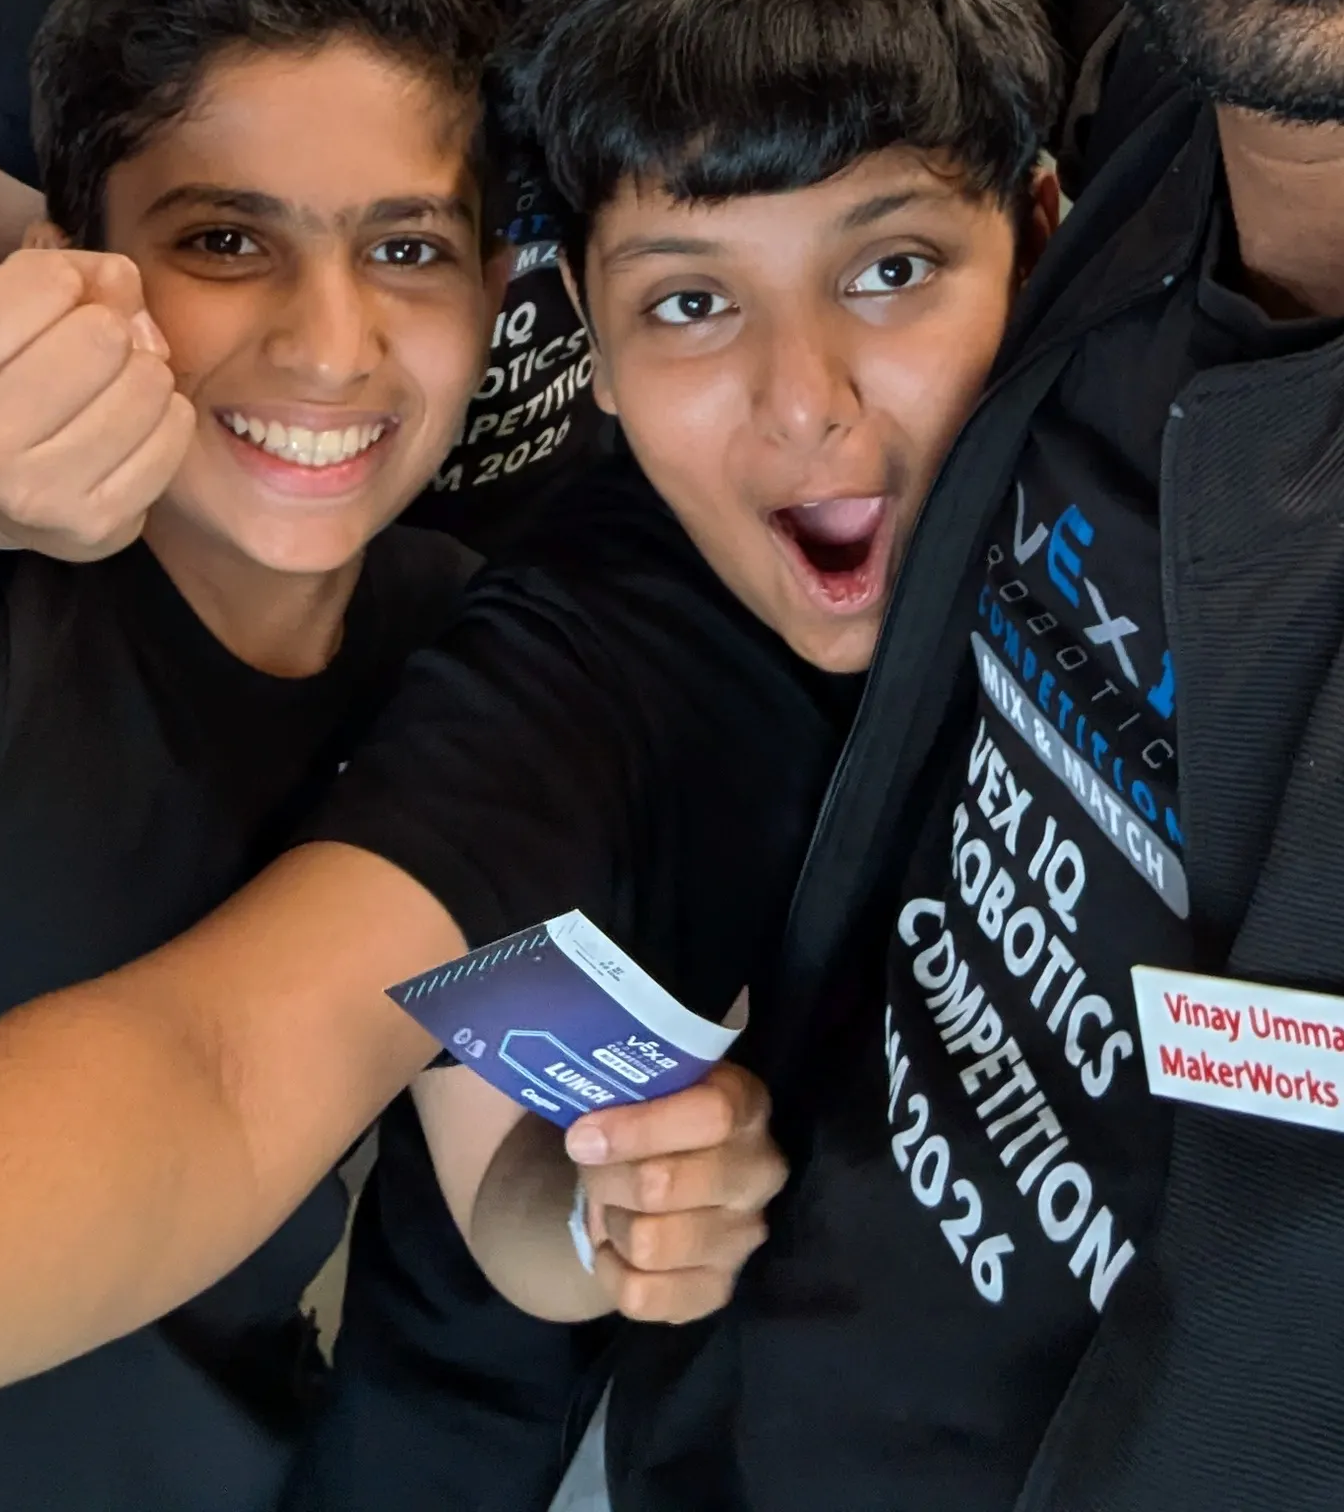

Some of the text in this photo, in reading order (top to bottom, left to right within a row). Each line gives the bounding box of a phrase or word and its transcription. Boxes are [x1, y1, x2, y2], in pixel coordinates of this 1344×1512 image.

[491, 301, 537, 347] IQ
[472, 413, 571, 485] 2026
[1013, 481, 1140, 688] VEX
[982, 654, 1025, 729] MIX
[1033, 718, 1052, 759] &
[1062, 748, 1165, 890] MATCH
[967, 716, 1086, 933] VEX IQ
[627, 1035, 664, 1061] VEX
[1164, 992, 1241, 1042] Vinay
[544, 1062, 616, 1104] LUNCH
[897, 898, 1136, 1312] COMPETITION
[1159, 1044, 1339, 1108] MakerWorks
[892, 1093, 1015, 1303] 2026
